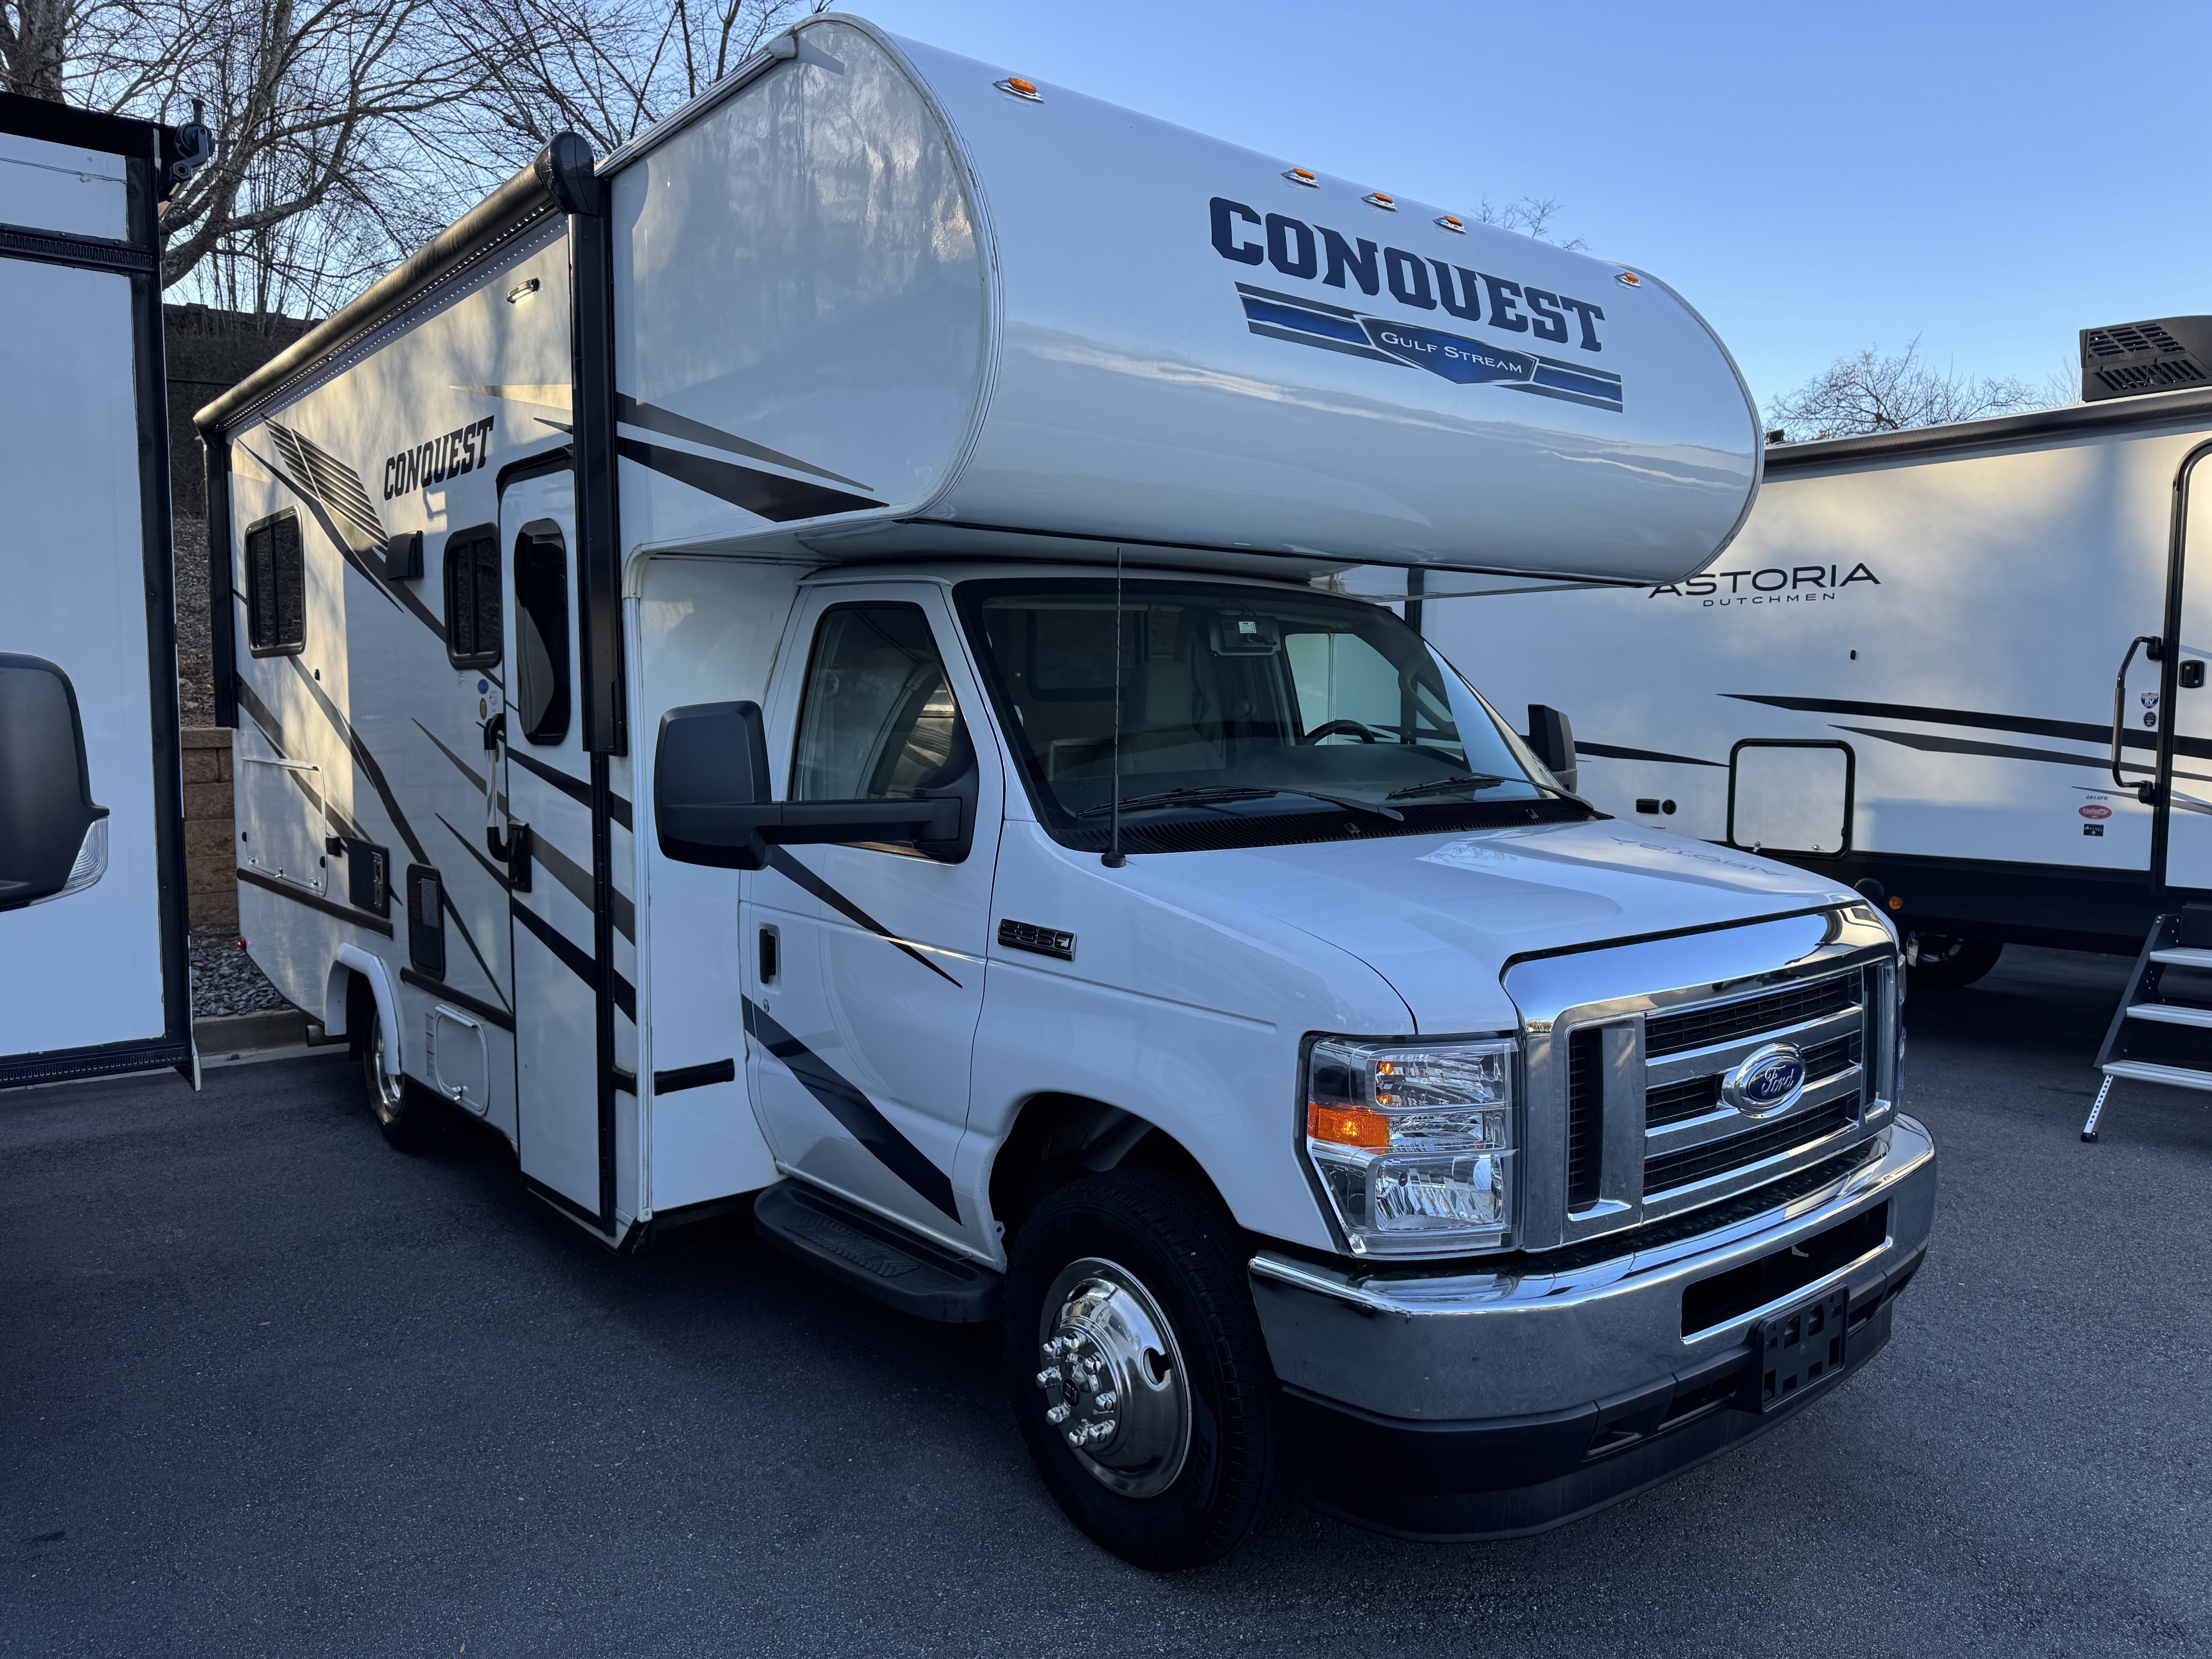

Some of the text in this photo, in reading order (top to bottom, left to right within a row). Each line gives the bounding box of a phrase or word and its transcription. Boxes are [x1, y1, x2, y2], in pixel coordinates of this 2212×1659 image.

[1210, 196, 1606, 352] CONQUEST
[383, 414, 495, 501] CONQUEST
[1703, 592, 1836, 607] DUTCHMEN
[1761, 1065, 1795, 1097] Ford
